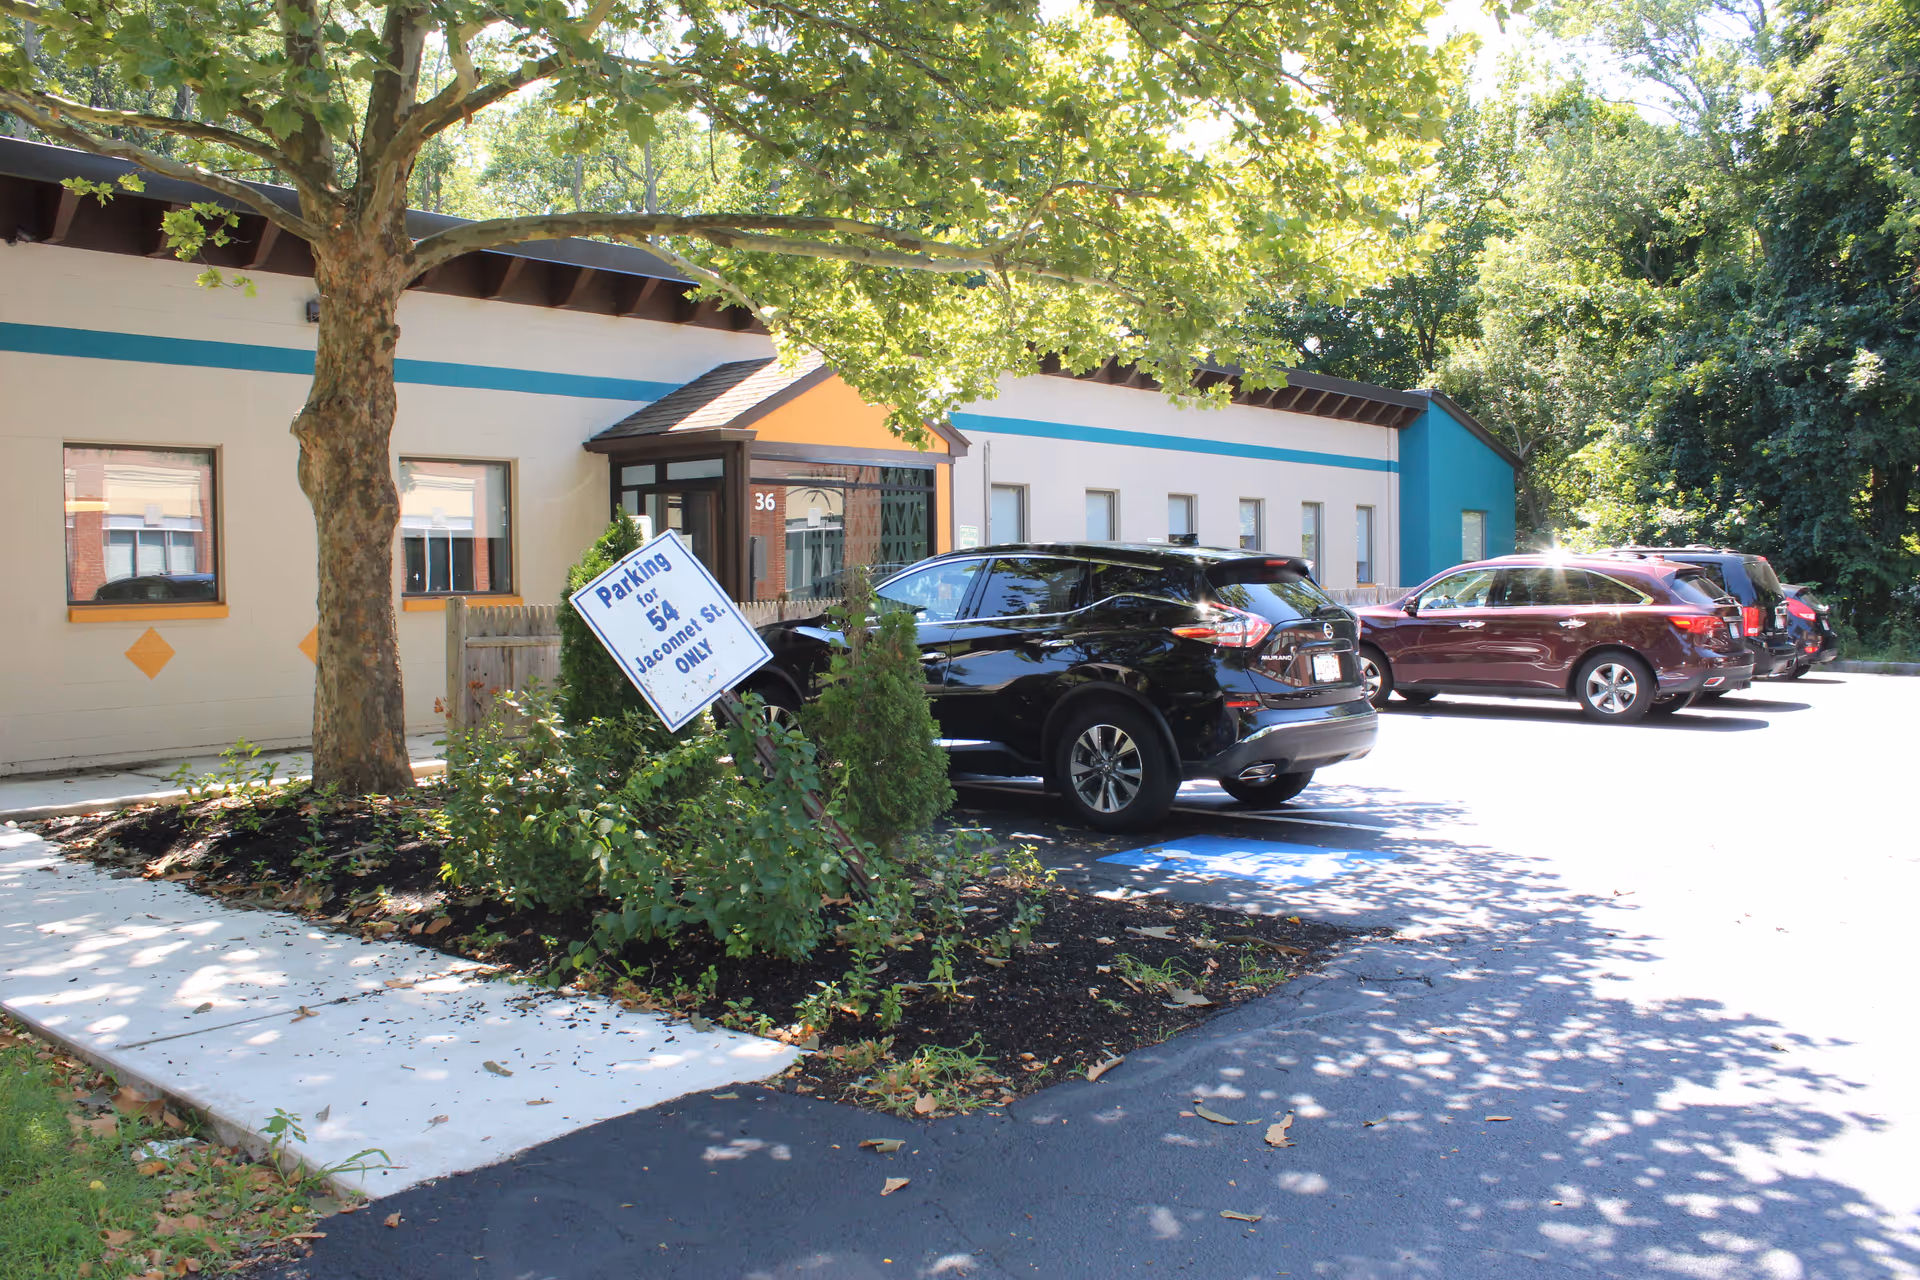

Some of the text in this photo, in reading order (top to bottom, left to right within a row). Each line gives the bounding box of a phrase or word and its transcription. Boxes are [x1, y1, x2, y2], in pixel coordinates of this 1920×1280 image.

[754, 492, 776, 511] 36
[595, 552, 672, 609] Parking
[636, 587, 659, 608] for
[645, 599, 681, 632] 54
[634, 602, 727, 674] Jaconnet St.
[674, 637, 714, 674] ONLY
